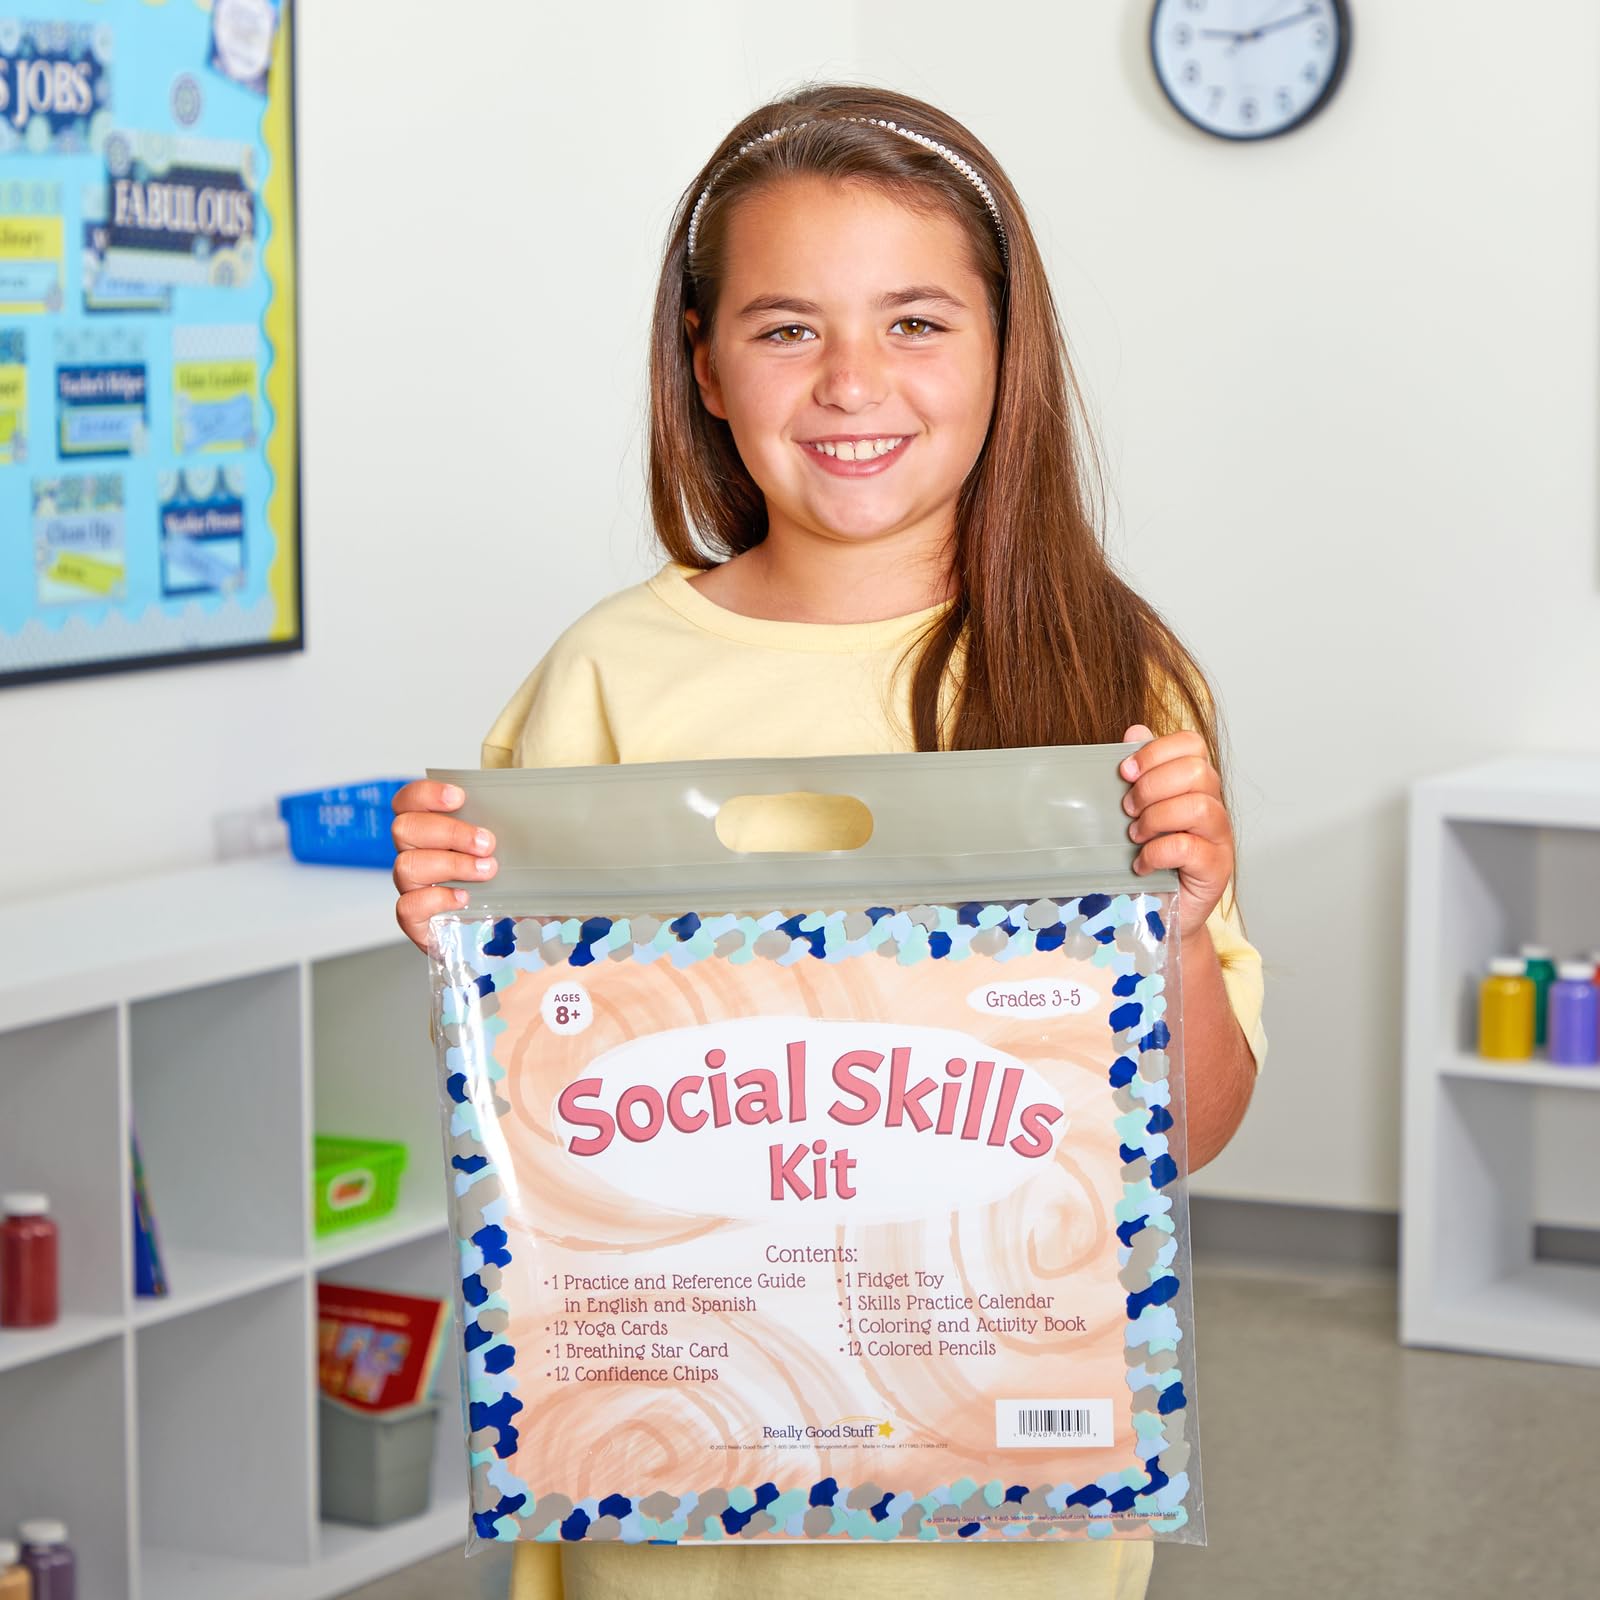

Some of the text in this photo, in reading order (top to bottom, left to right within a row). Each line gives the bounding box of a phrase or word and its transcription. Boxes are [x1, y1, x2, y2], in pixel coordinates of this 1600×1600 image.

[14, 59, 92, 126] JOBS
[114, 179, 252, 234] FABULOUS
[554, 994, 580, 1003] AGES
[985, 989, 1081, 1007] Grades 3-5
[555, 1006, 581, 1025] 8+
[557, 1040, 1064, 1158] Social Skills
[769, 1139, 857, 1201] Kit
[765, 1245, 858, 1263] Contents:
[564, 1274, 629, 1290] Practice
[634, 1275, 666, 1290] and
[672, 1274, 752, 1290] Reference
[757, 1273, 806, 1289] Guide
[857, 1272, 909, 1290] Fidget
[914, 1271, 944, 1291] Toy
[564, 1296, 757, 1315] in English and Spanish
[858, 1295, 901, 1311] Skills
[907, 1294, 973, 1310] Practice
[978, 1293, 1055, 1309] Calendar
[554, 1319, 668, 1338] 12 Yoga Cards
[858, 1317, 931, 1336] Coloring
[937, 1317, 970, 1333] and
[976, 1316, 1038, 1335] Activity
[1044, 1315, 1087, 1332] Book
[566, 1343, 646, 1360] Breathing
[651, 1342, 684, 1359] Star
[689, 1342, 729, 1358] Card
[847, 1339, 996, 1357] 12 Colored Pencils
[554, 1364, 719, 1383] 12 Confidence Chips
[763, 1425, 802, 1441] Really
[805, 1425, 840, 1438] Good
